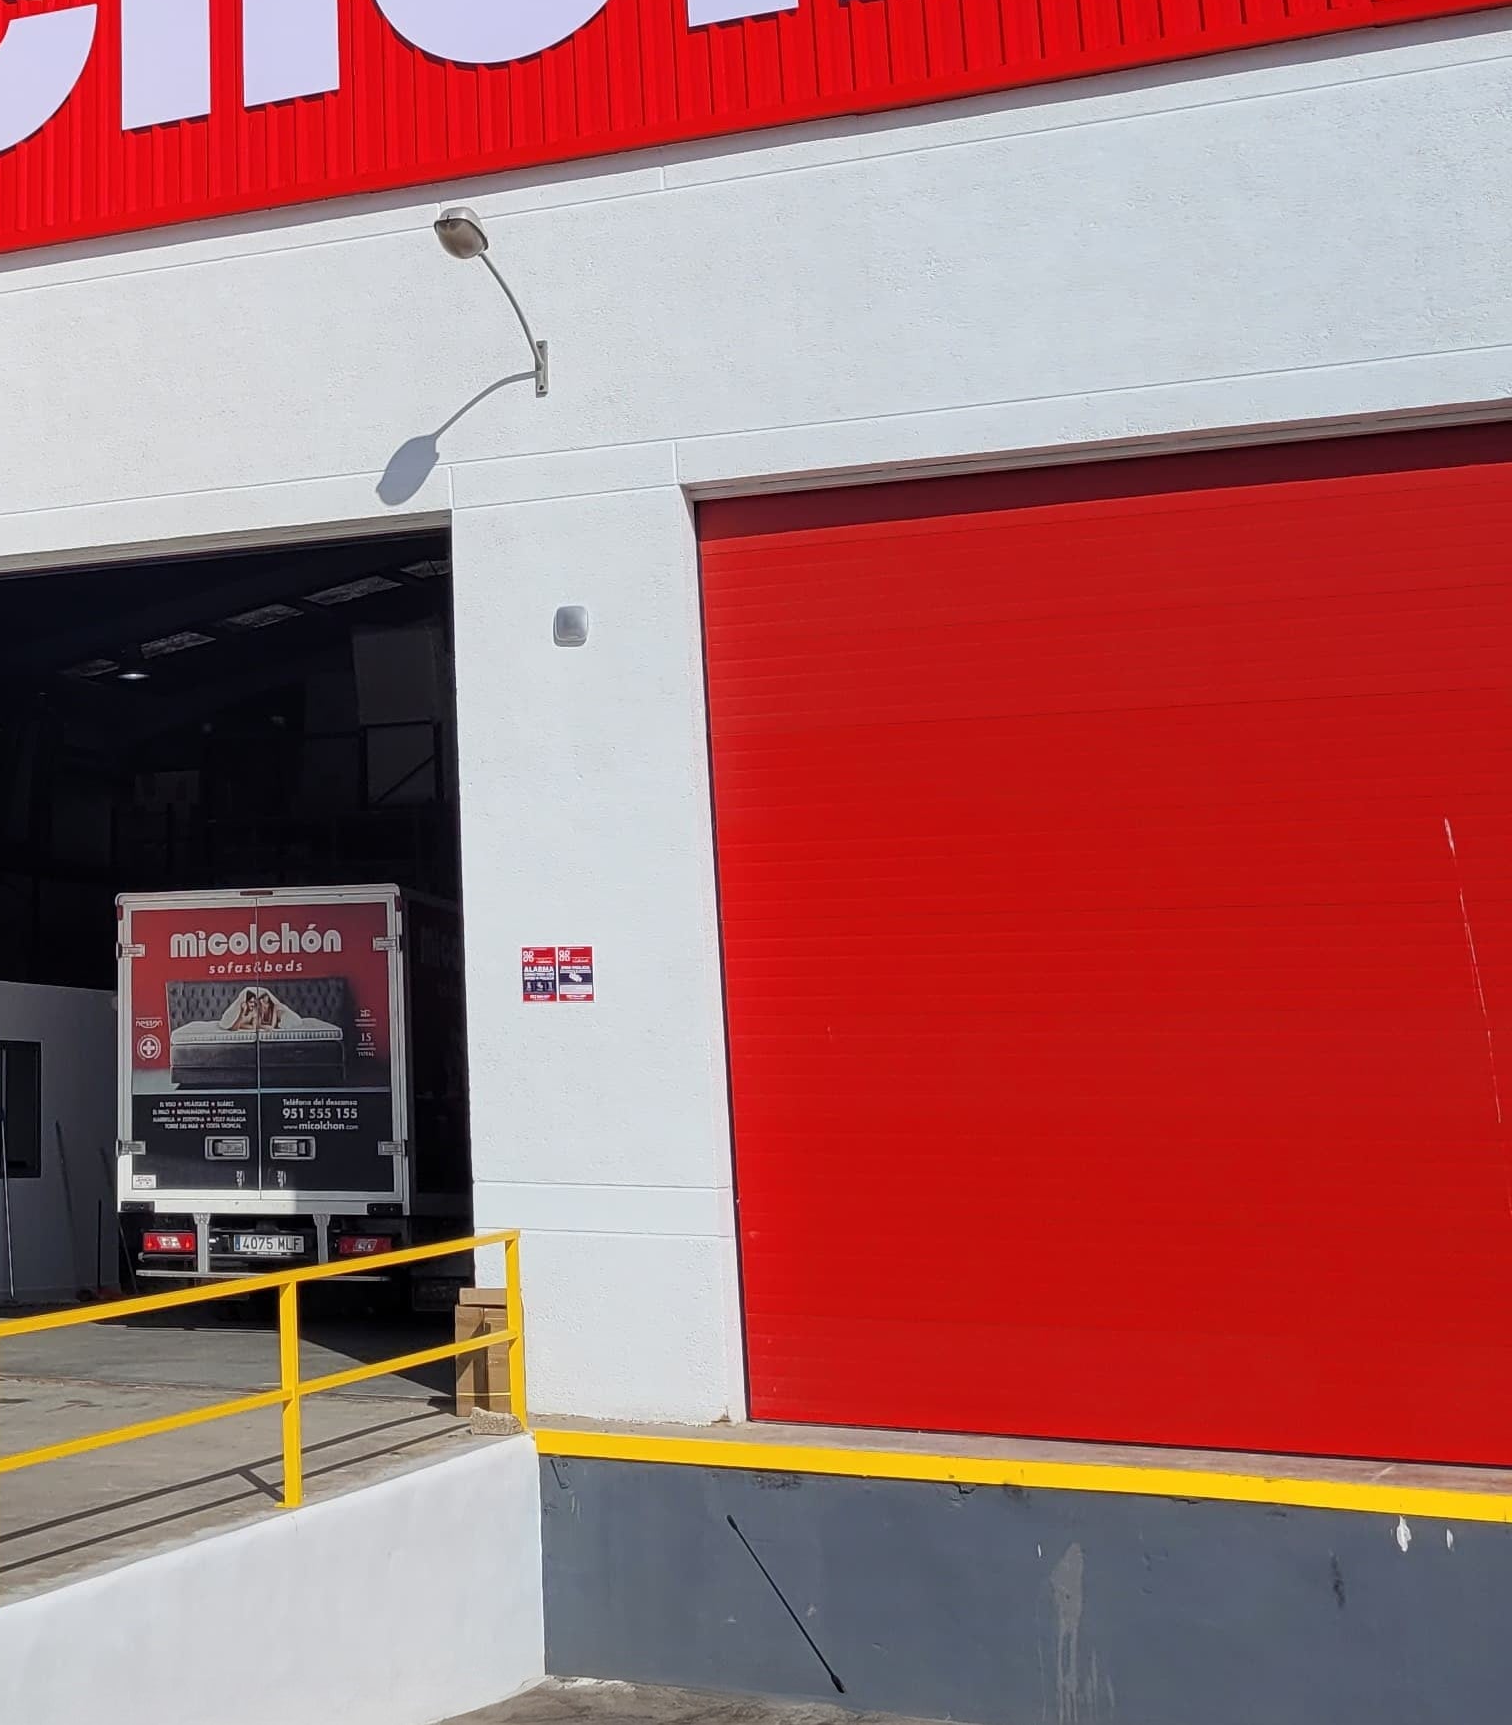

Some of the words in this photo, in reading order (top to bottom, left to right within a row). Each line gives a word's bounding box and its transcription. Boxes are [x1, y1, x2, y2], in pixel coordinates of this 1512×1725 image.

[170, 922, 342, 958] micolchón
[208, 959, 303, 974] sofas&beds
[361, 1032, 372, 1042] 15
[313, 1098, 324, 1106] del
[282, 1108, 304, 1119] 951
[309, 1107, 332, 1119] 555
[336, 1107, 358, 1119] 155
[242, 1237, 273, 1250] 4075
[278, 1237, 302, 1251] MLF
